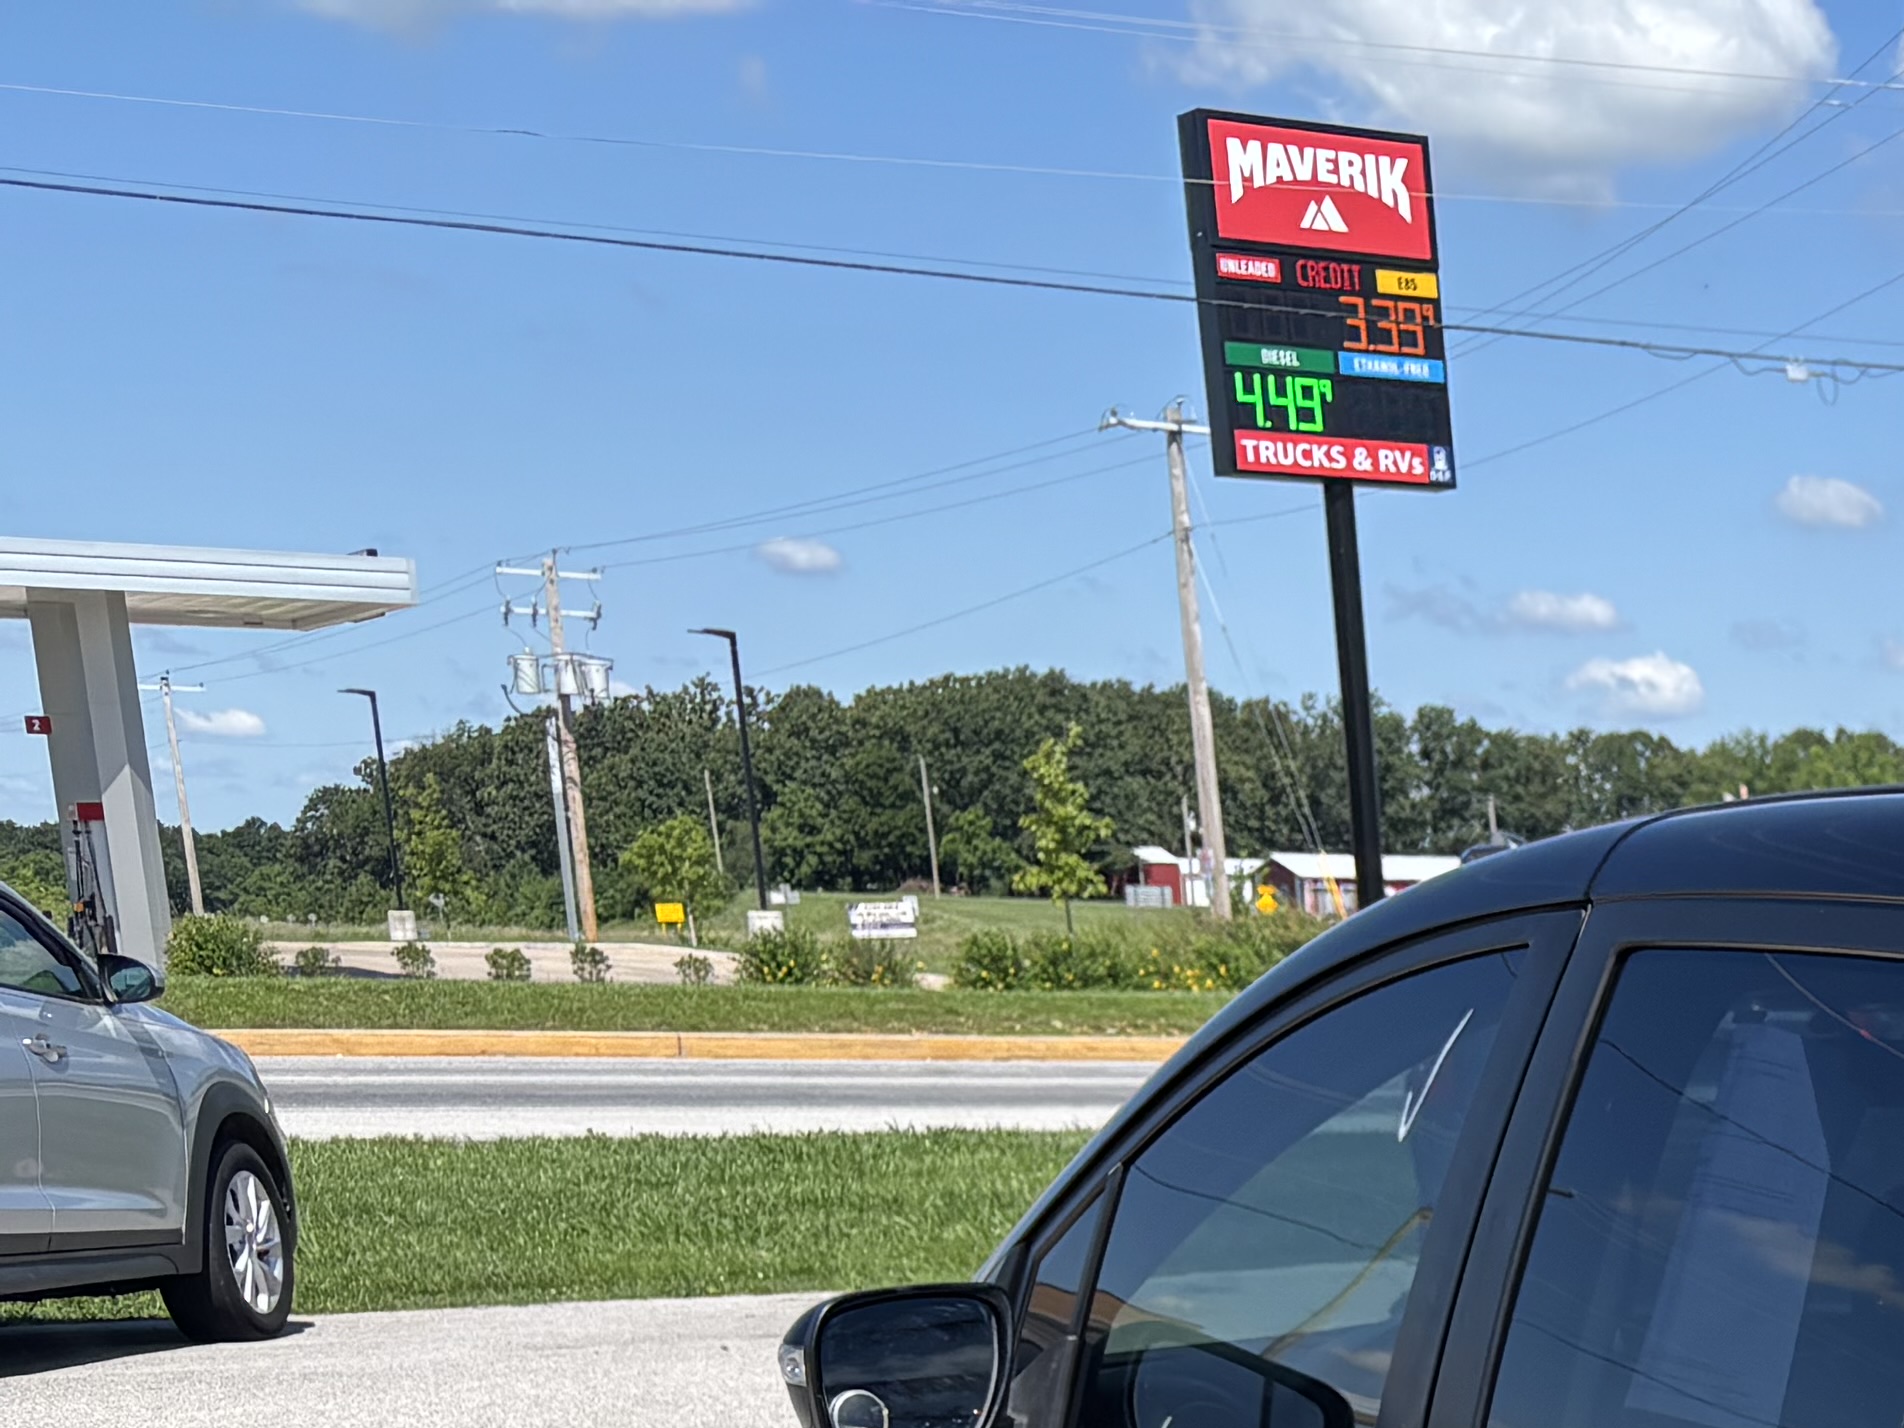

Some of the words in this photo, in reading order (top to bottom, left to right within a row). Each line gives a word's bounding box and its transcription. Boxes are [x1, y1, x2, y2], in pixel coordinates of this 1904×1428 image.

[1225, 137, 1412, 224] MAVERIK
[1219, 258, 1275, 277] UNLEADED
[1296, 259, 1361, 291] CREDIT
[1260, 348, 1300, 367] DIESEL
[1240, 438, 1347, 470] TRUCKS
[1352, 445, 1373, 471] &
[1378, 447, 1425, 475] RVs
[32, 720, 41, 731] 2
